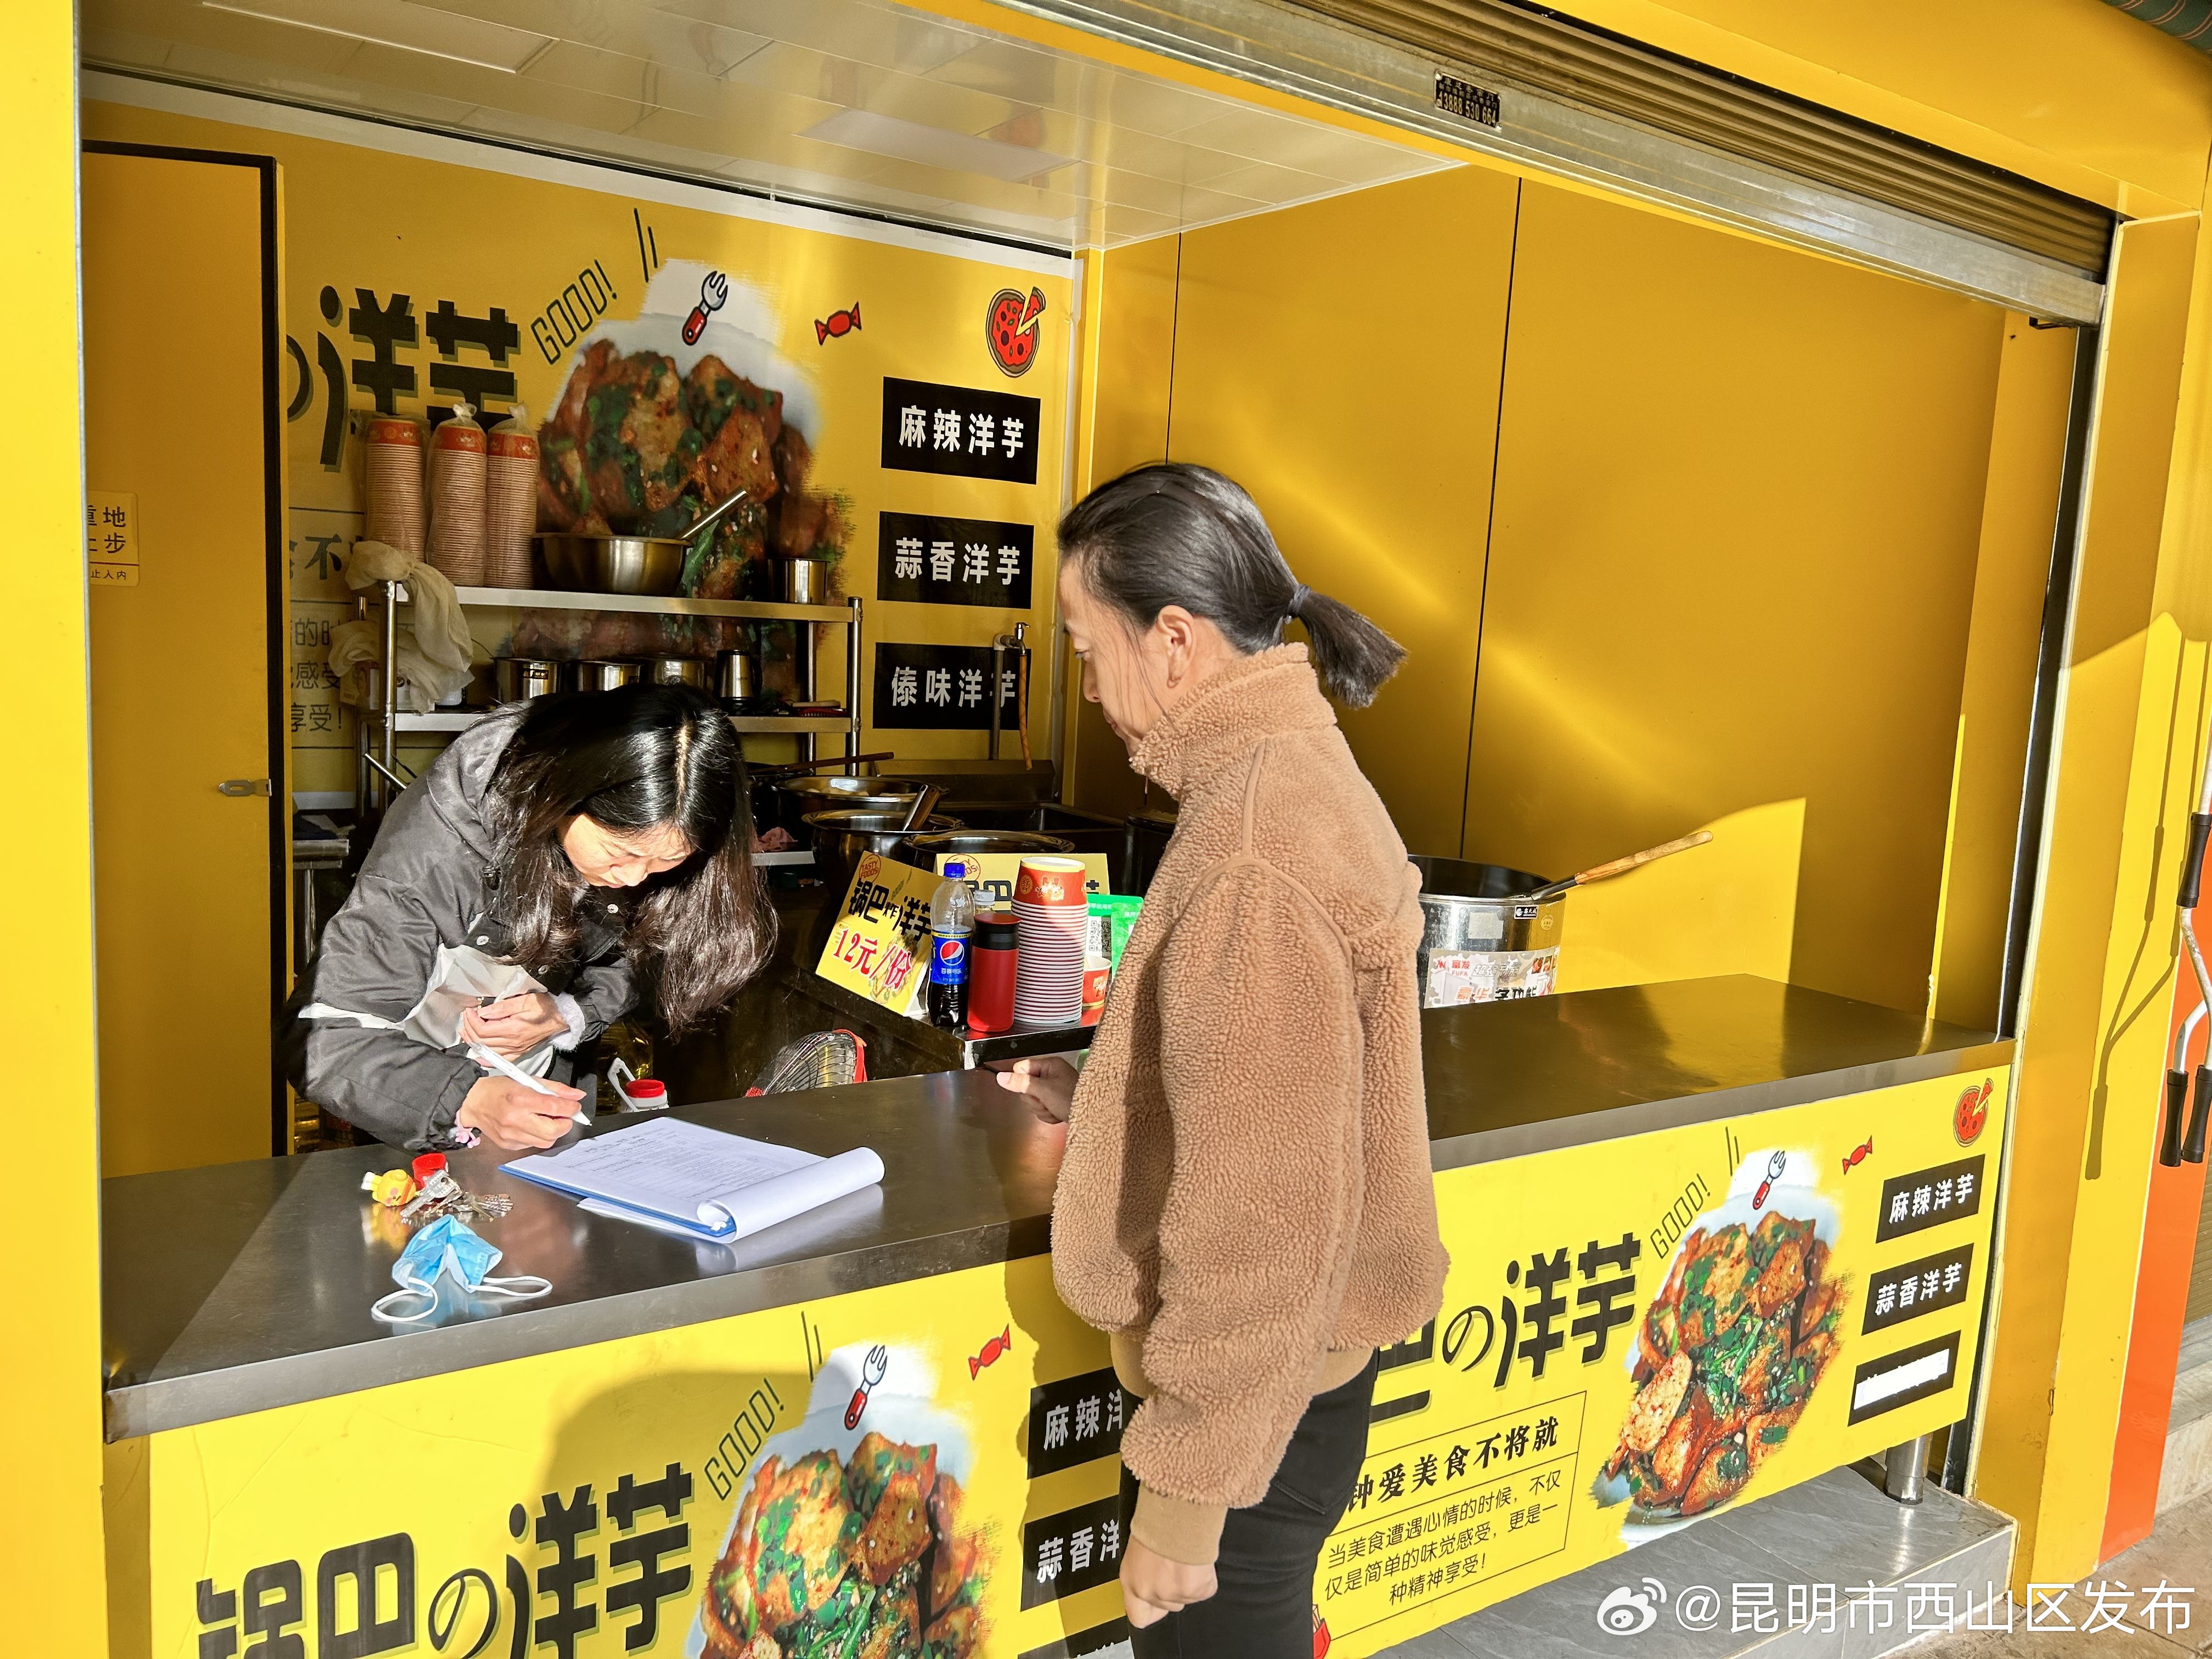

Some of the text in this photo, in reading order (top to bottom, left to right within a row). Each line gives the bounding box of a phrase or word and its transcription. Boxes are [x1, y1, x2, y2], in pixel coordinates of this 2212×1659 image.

[1465, 100, 1480, 120] 530
[531, 259, 617, 365] GOOD!
[899, 405, 1024, 458] 麻辣洋芋
[895, 537, 1020, 585] 蒜香洋芋
[891, 665, 1016, 708] 傣味洋芋
[861, 860, 878, 872] TASTY
[833, 929, 912, 989] 12元/份
[1650, 1173, 1711, 1259] GOOD!
[1888, 1172, 1974, 1224] 麻辣洋芋
[1875, 1262, 1962, 1317] 蒜香洋芋
[704, 1378, 785, 1502] GOOD!
[1347, 1415, 1559, 1513] 钟爱美食不将就
